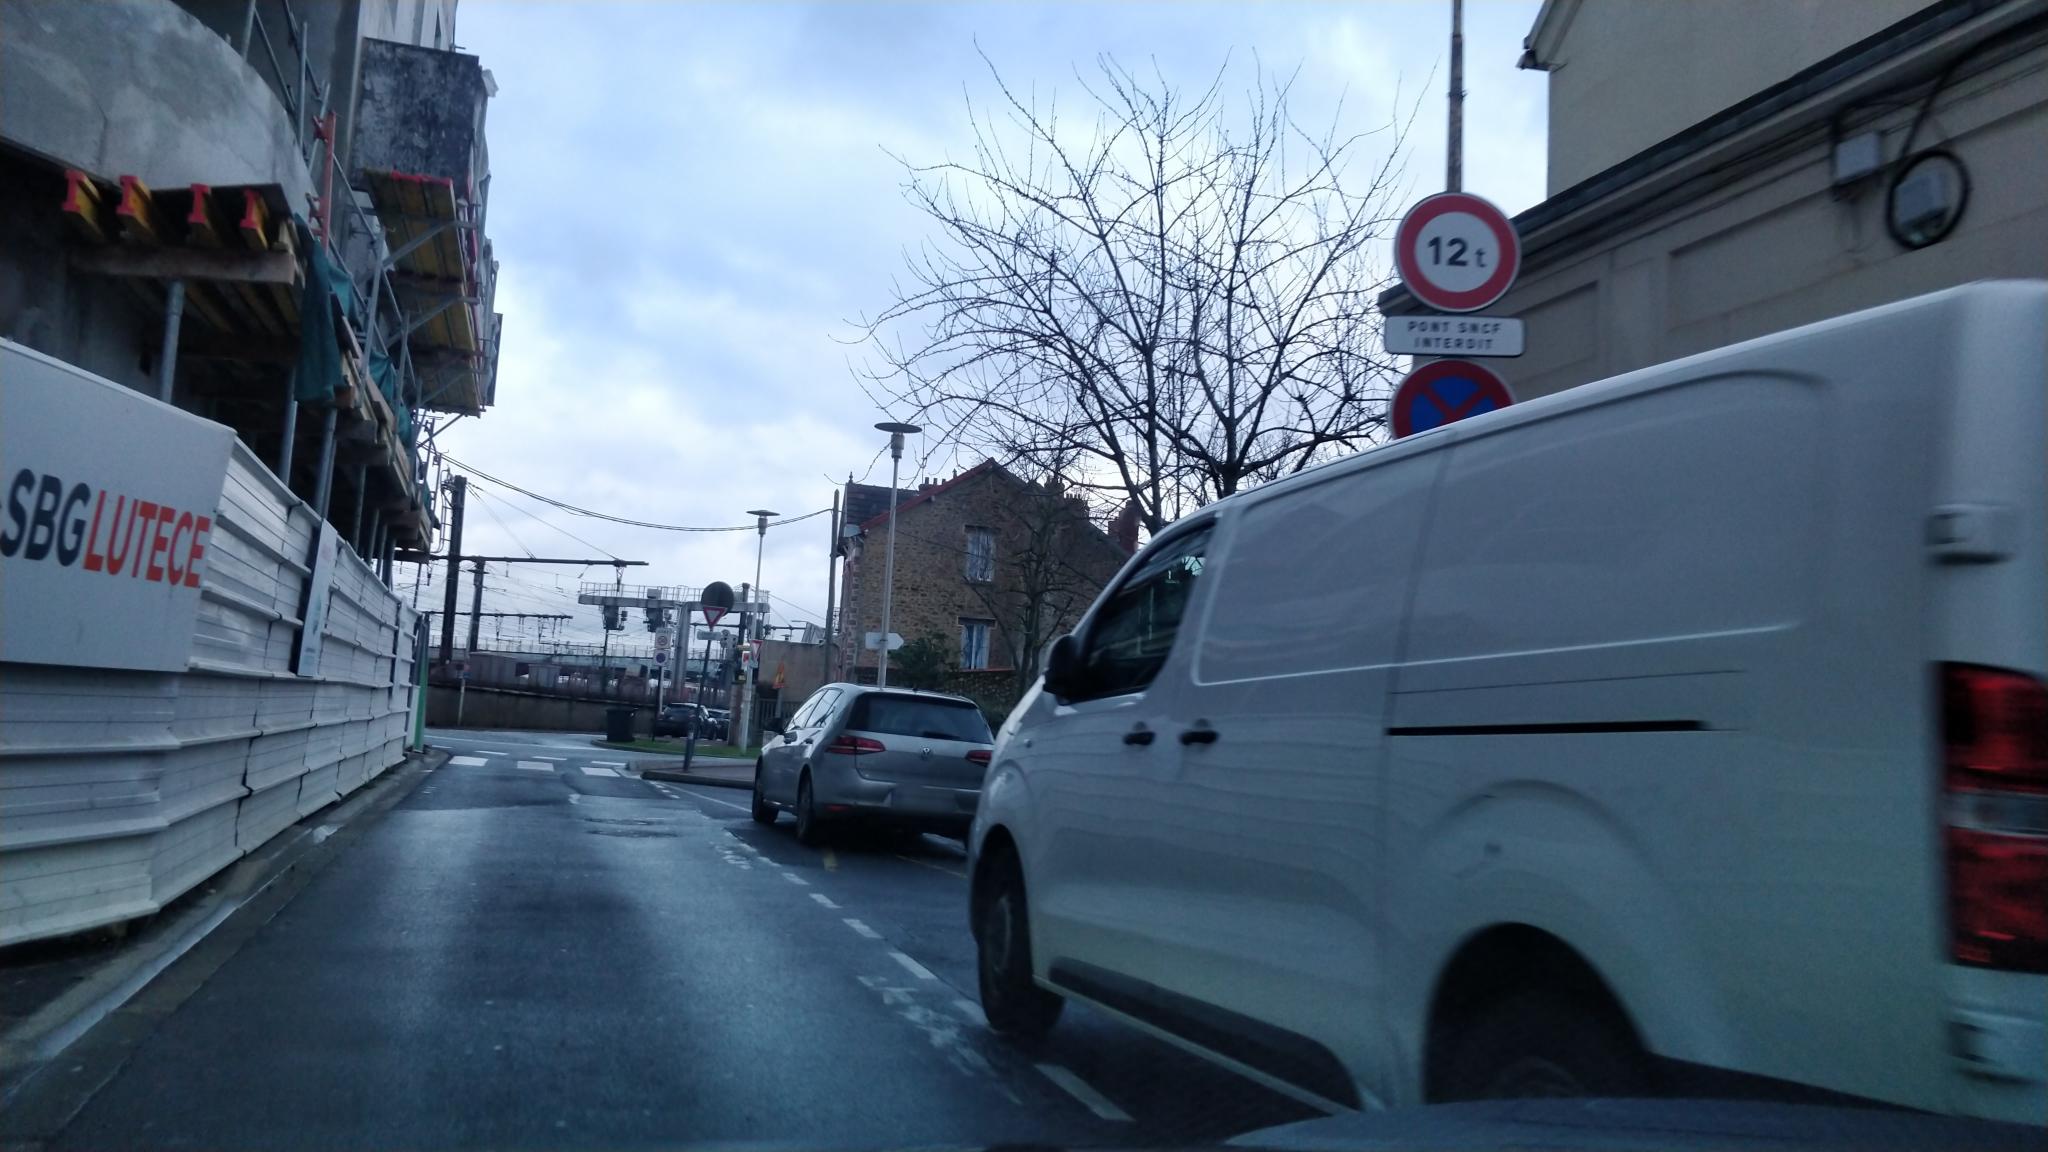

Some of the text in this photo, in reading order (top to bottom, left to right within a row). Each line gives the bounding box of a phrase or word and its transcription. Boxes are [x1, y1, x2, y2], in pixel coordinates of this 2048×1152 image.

[1407, 320, 1502, 335] PONT SNCF
[1414, 336, 1494, 350] INTERDIT
